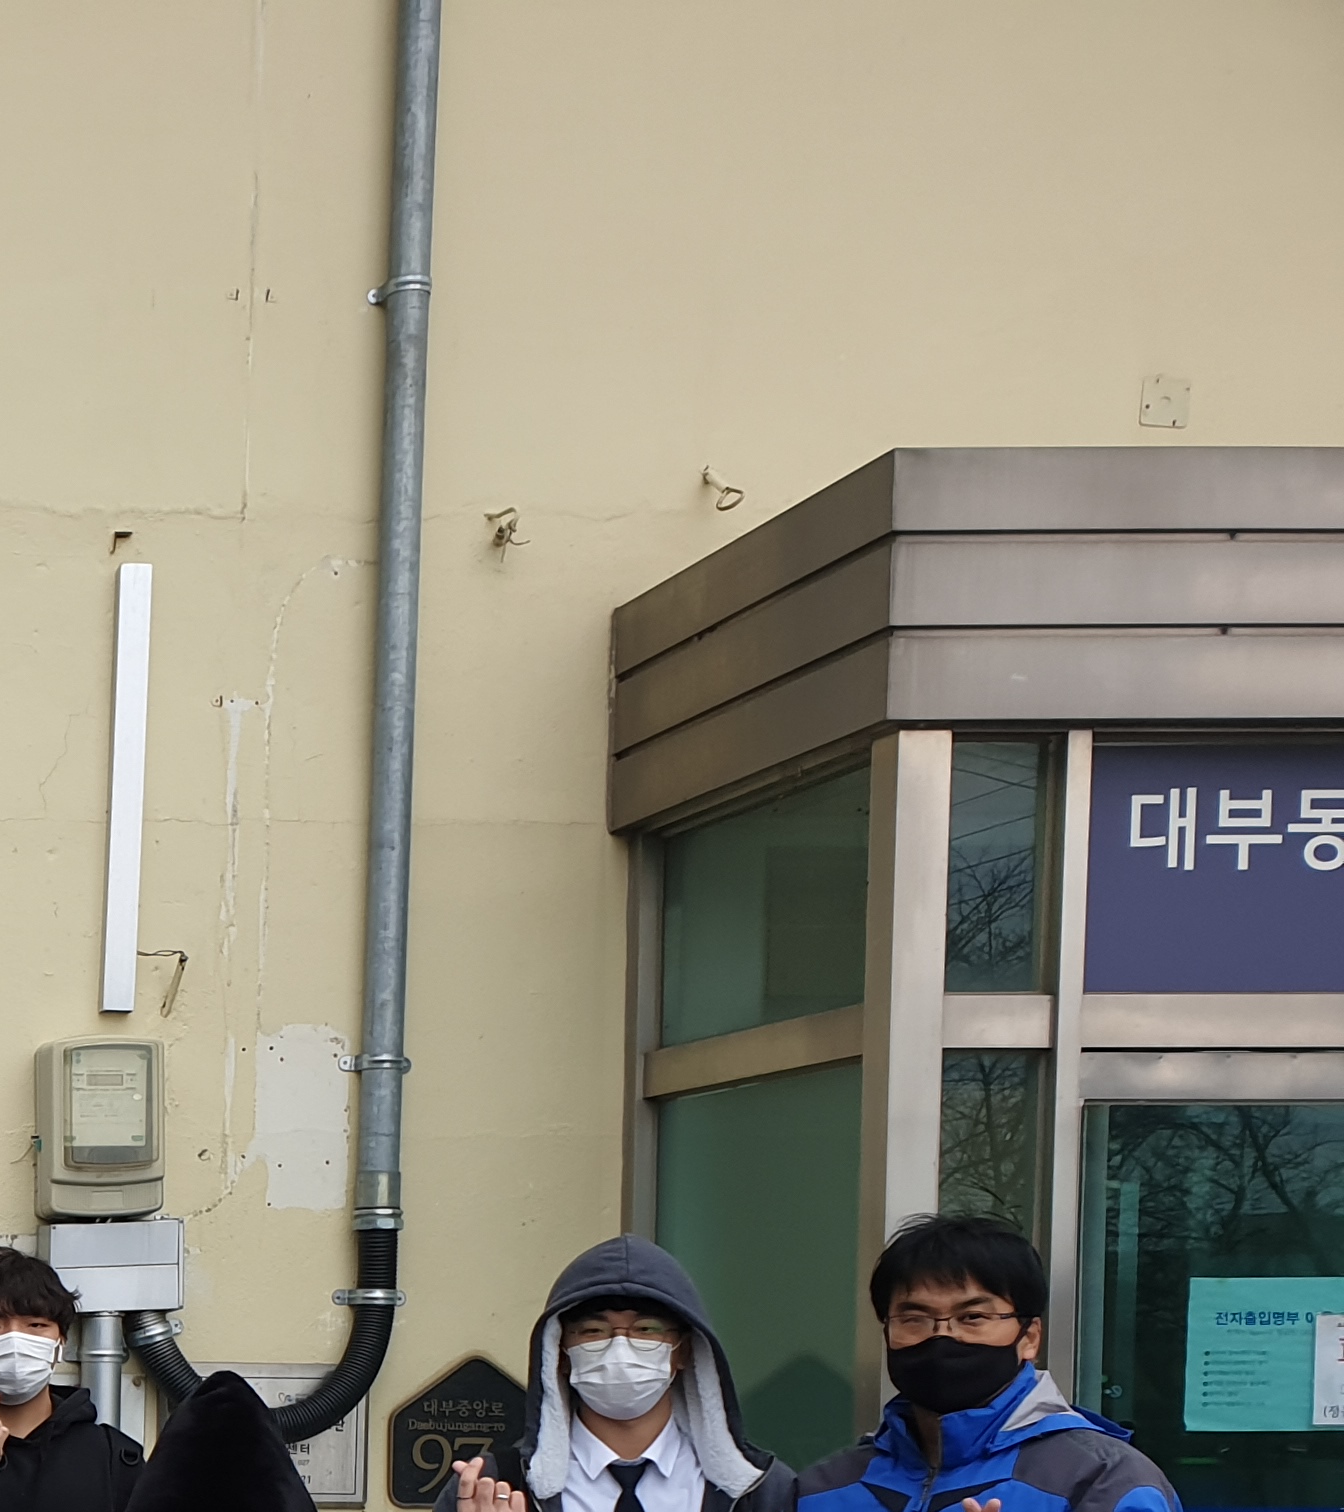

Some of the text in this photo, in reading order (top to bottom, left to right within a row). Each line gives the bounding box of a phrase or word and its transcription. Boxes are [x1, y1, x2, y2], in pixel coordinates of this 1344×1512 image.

[1130, 787, 1344, 871] 대부동
[1215, 1311, 1300, 1326] 전자출입명부
[423, 1399, 506, 1418] 대부중앙로
